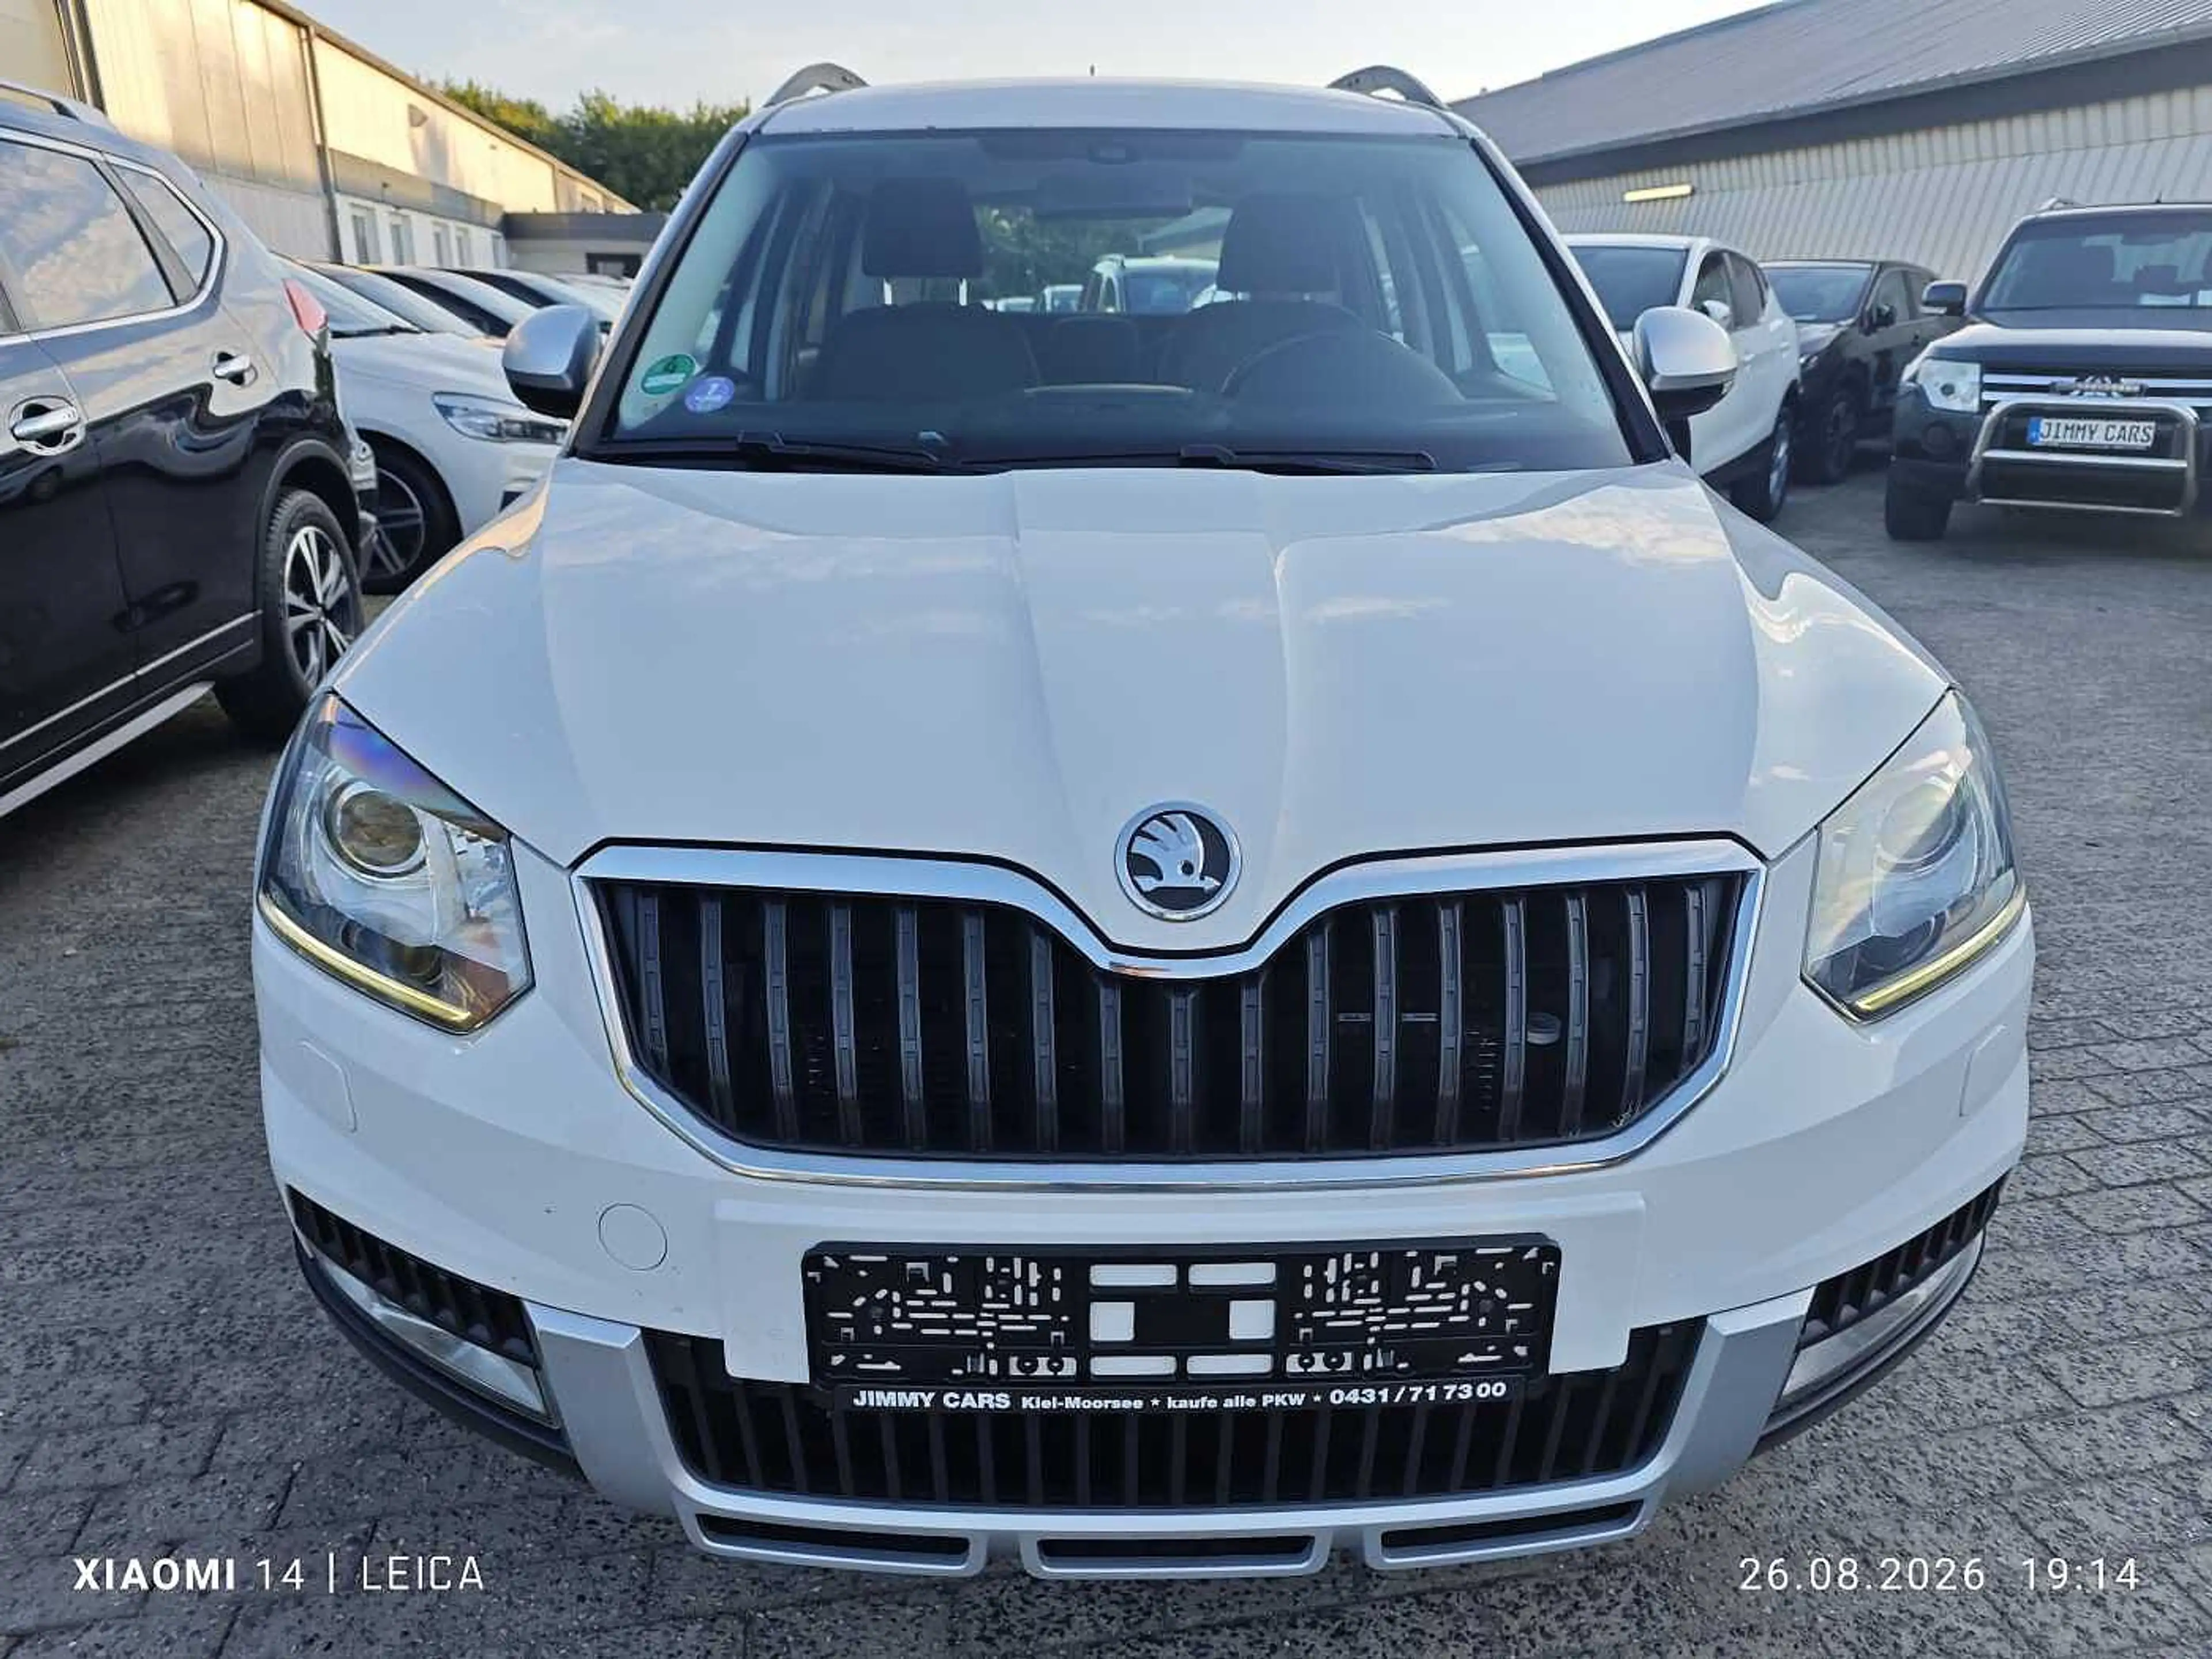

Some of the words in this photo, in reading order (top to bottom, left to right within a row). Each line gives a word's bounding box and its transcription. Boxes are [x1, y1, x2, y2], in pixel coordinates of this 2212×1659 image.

[2040, 422, 2099, 440] JIMMY
[2104, 425, 2153, 444] CARS
[853, 1390, 935, 1407] JIMMY
[943, 1392, 1012, 1409] CARS
[1021, 1396, 1144, 1409] Kiel-Moorsee
[1166, 1396, 1218, 1409] kaufe
[1223, 1395, 1257, 1408] alle
[1262, 1393, 1306, 1407] PKW
